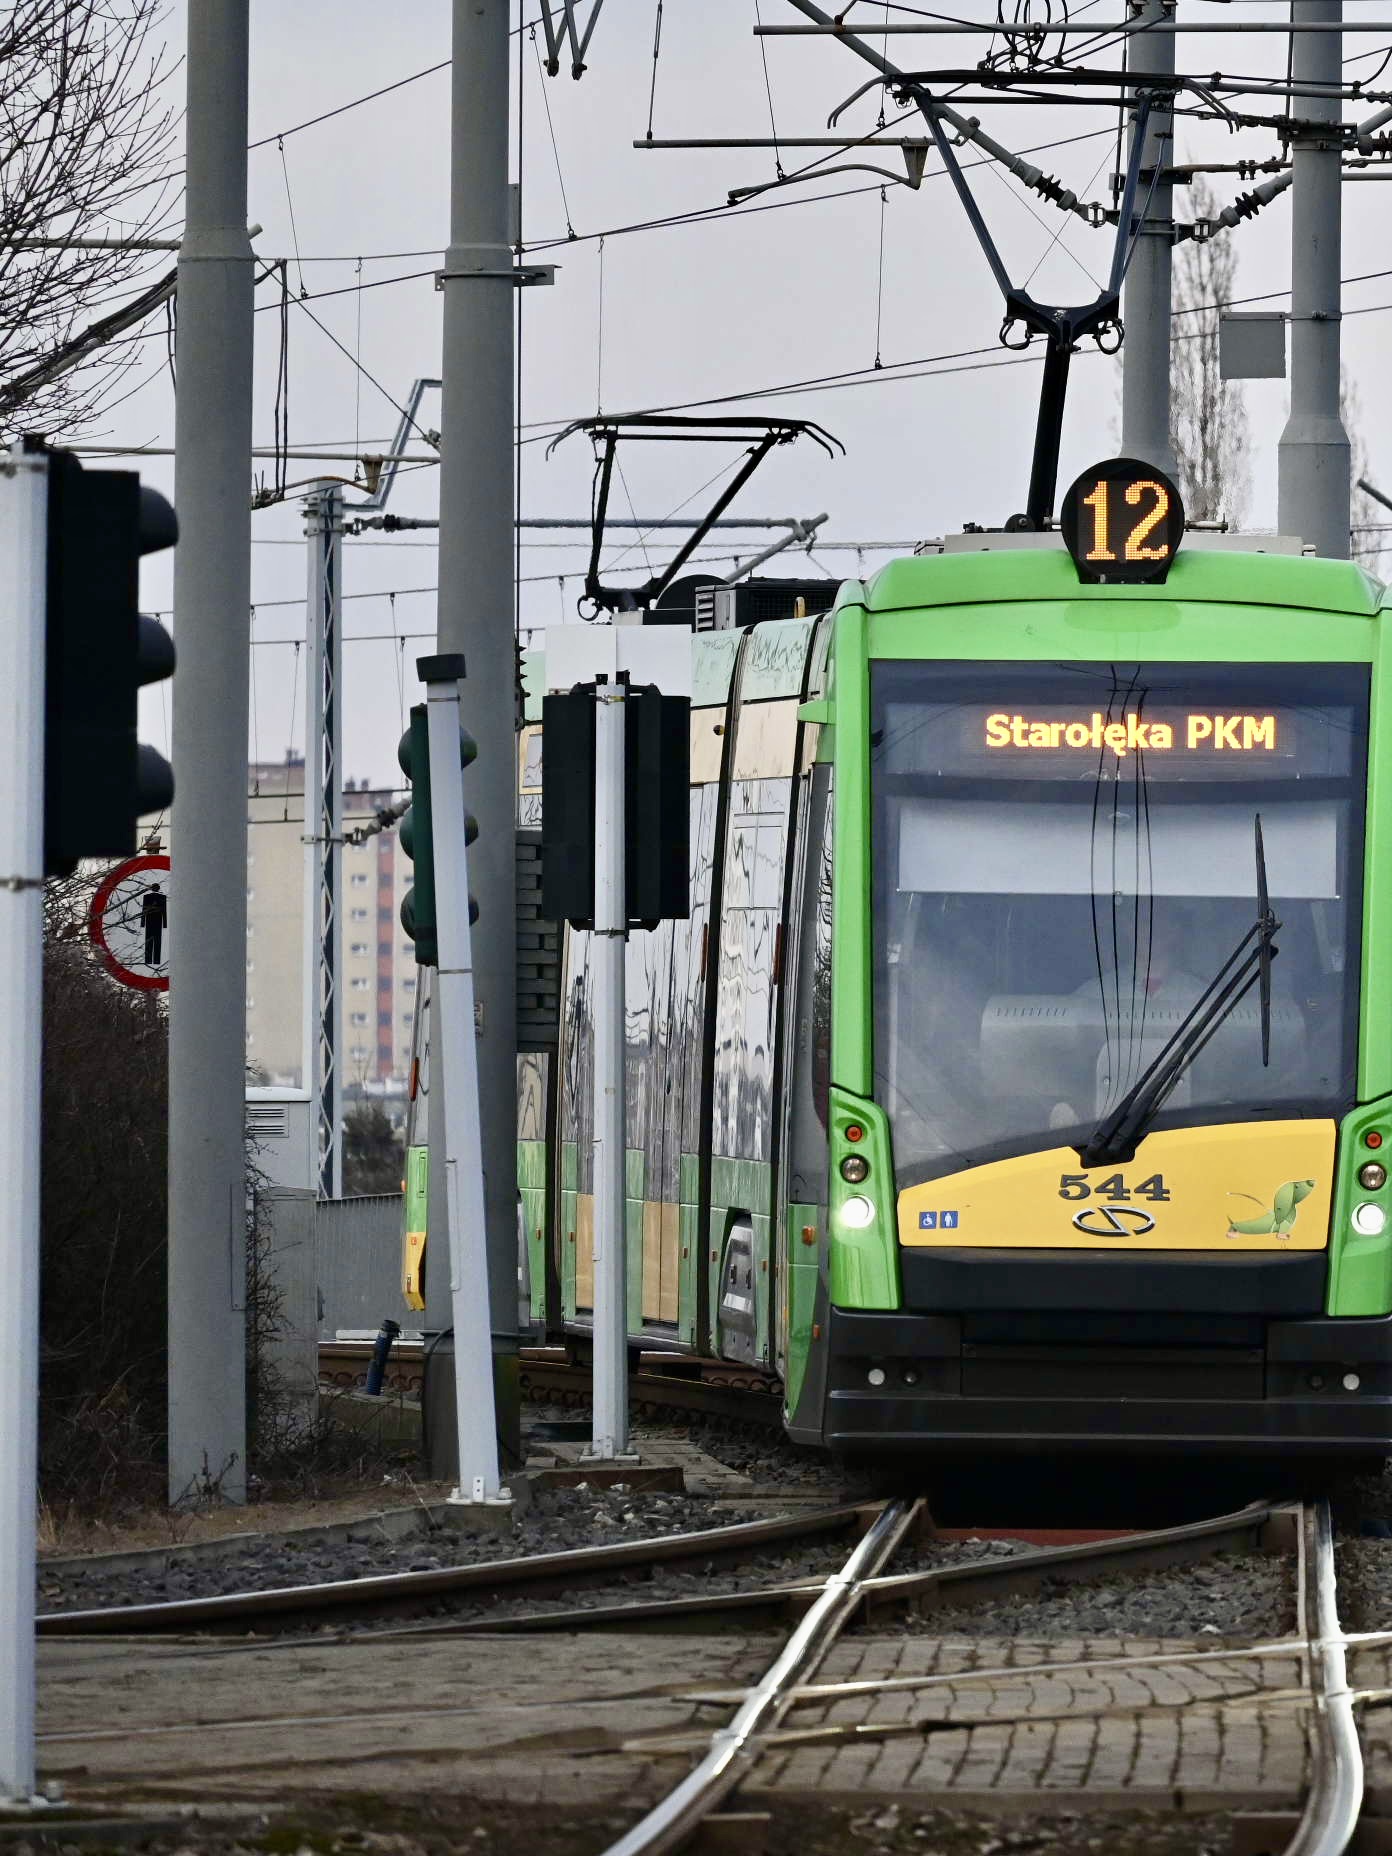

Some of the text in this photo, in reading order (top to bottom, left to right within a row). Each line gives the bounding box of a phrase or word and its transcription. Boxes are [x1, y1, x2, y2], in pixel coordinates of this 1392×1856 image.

[1083, 480, 1168, 560] 12
[986, 713, 1275, 756] Starołęka PKM
[1058, 1173, 1171, 1201] 544
